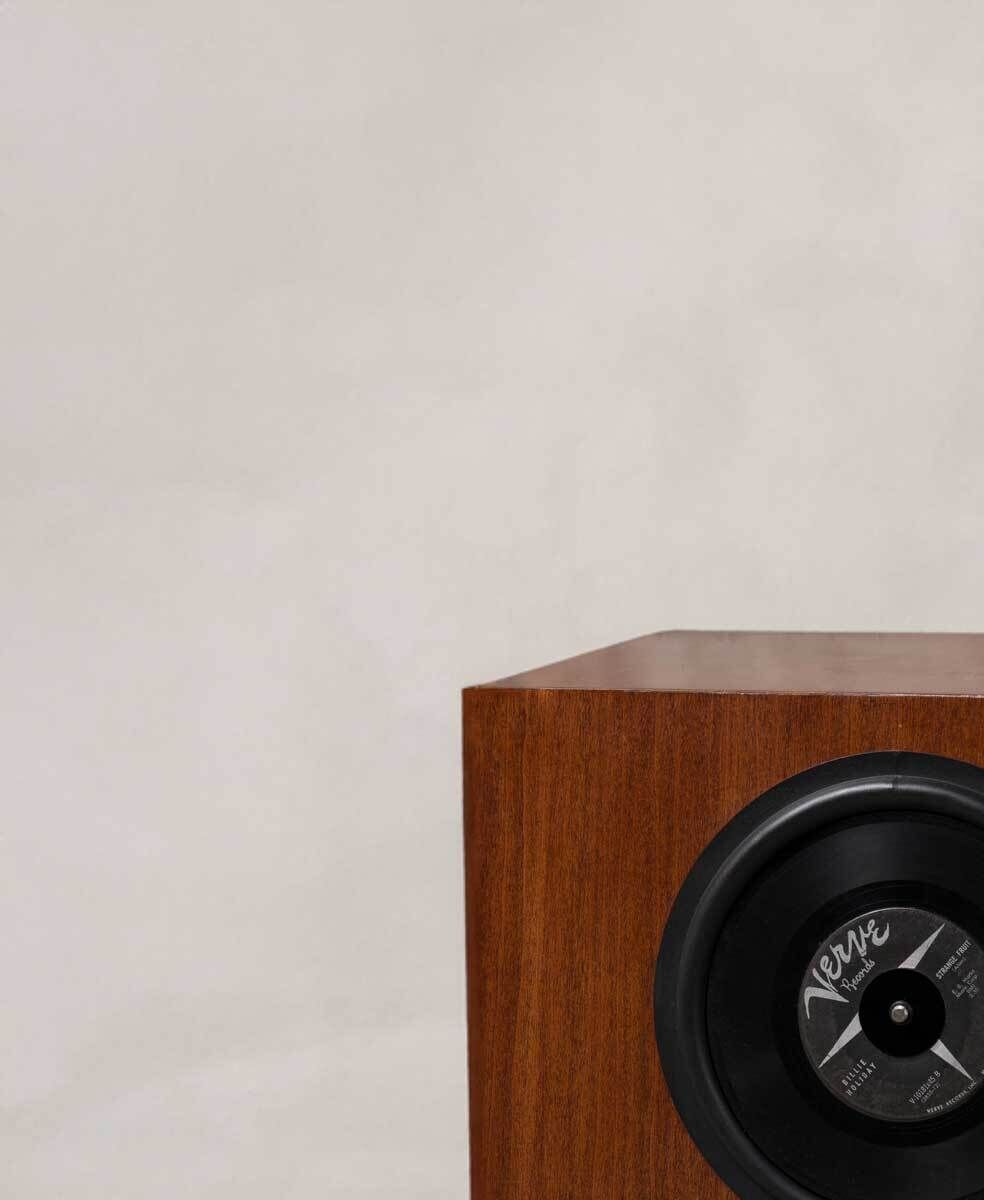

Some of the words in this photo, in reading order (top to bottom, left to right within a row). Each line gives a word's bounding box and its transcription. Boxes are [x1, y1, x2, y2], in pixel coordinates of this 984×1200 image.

[804, 919, 889, 1019] Verve
[840, 958, 876, 991] Records
[936, 955, 958, 980] STRANGE
[956, 940, 972, 956] FRUIT
[842, 1059, 866, 1086] BILLIE
[846, 1062, 876, 1096] HOLIDAY
